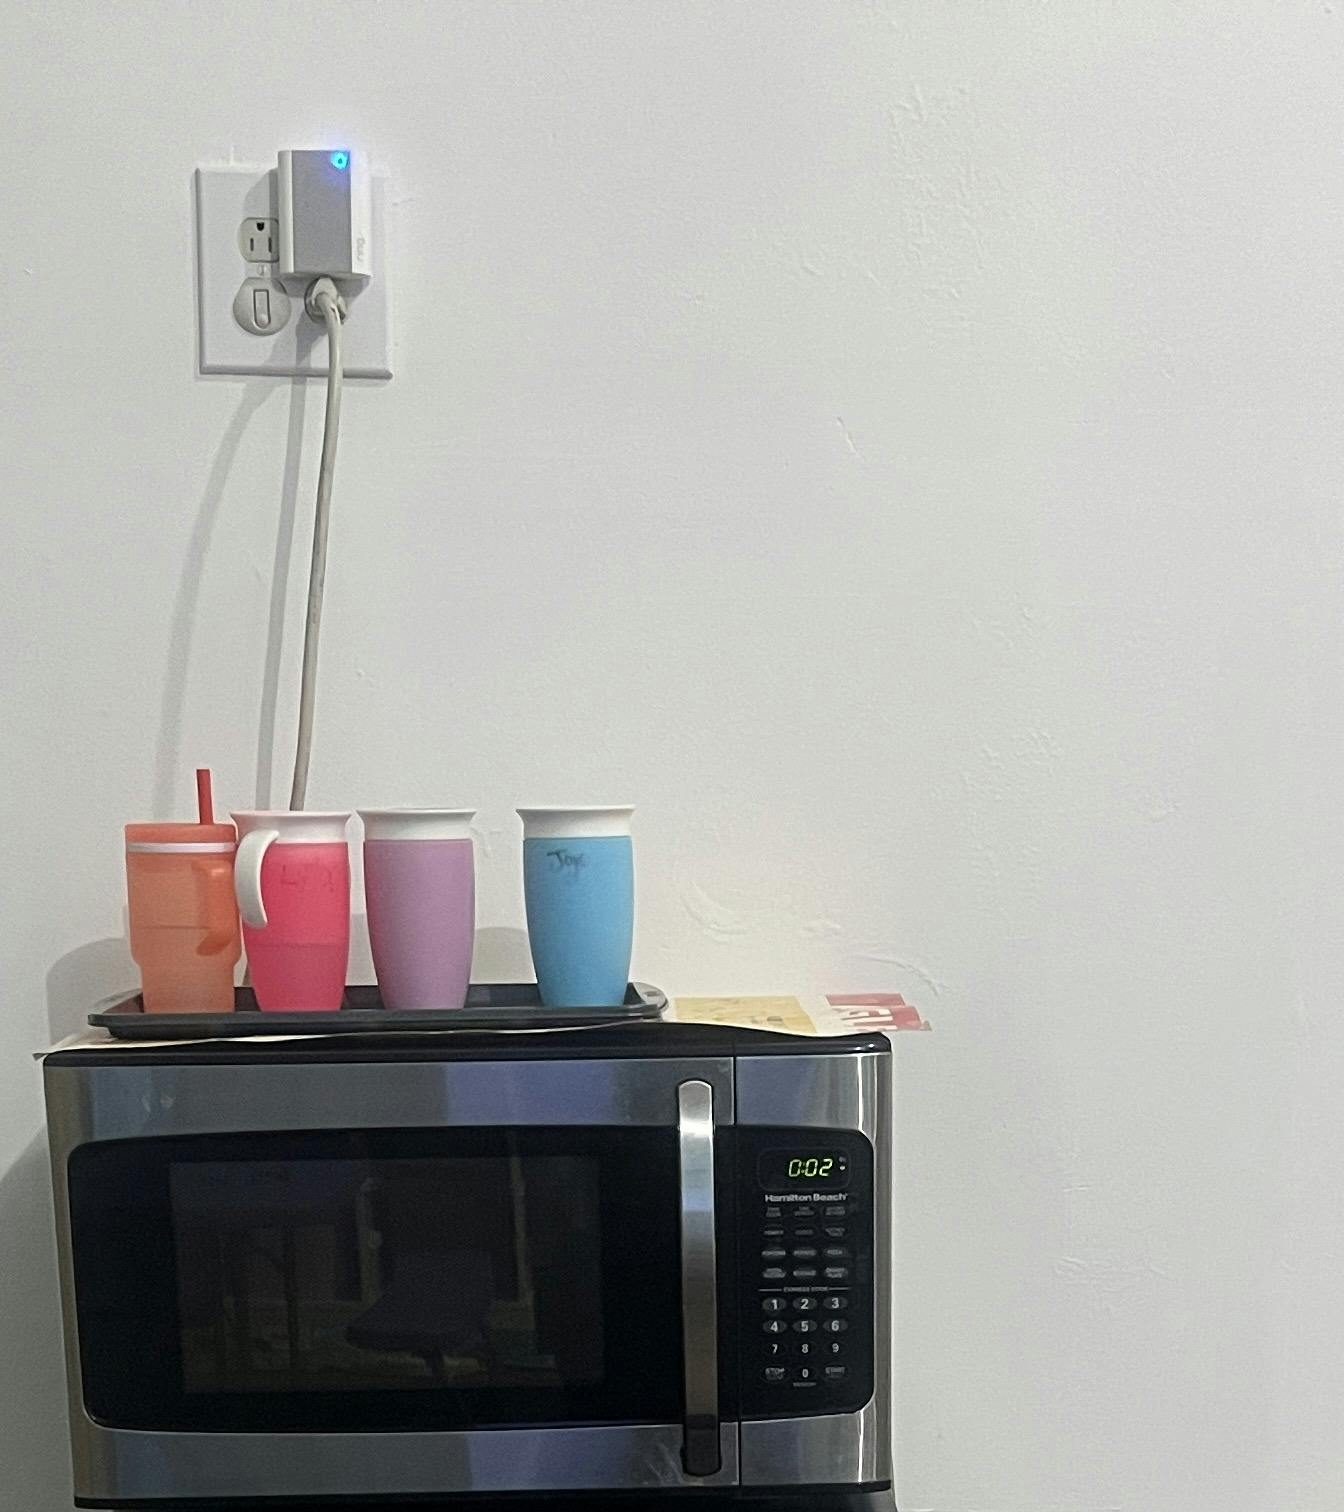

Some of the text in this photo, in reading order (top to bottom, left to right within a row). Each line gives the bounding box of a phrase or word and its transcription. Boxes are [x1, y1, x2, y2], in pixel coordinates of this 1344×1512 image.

[788, 1158, 833, 1177] 0:02
[764, 1193, 846, 1202] Hamilton Beach
[771, 1297, 840, 1310] 1 2 3
[770, 1320, 840, 1332] 4 5 6
[772, 1342, 840, 1354] 7 8 9
[802, 1368, 809, 1378] 0
